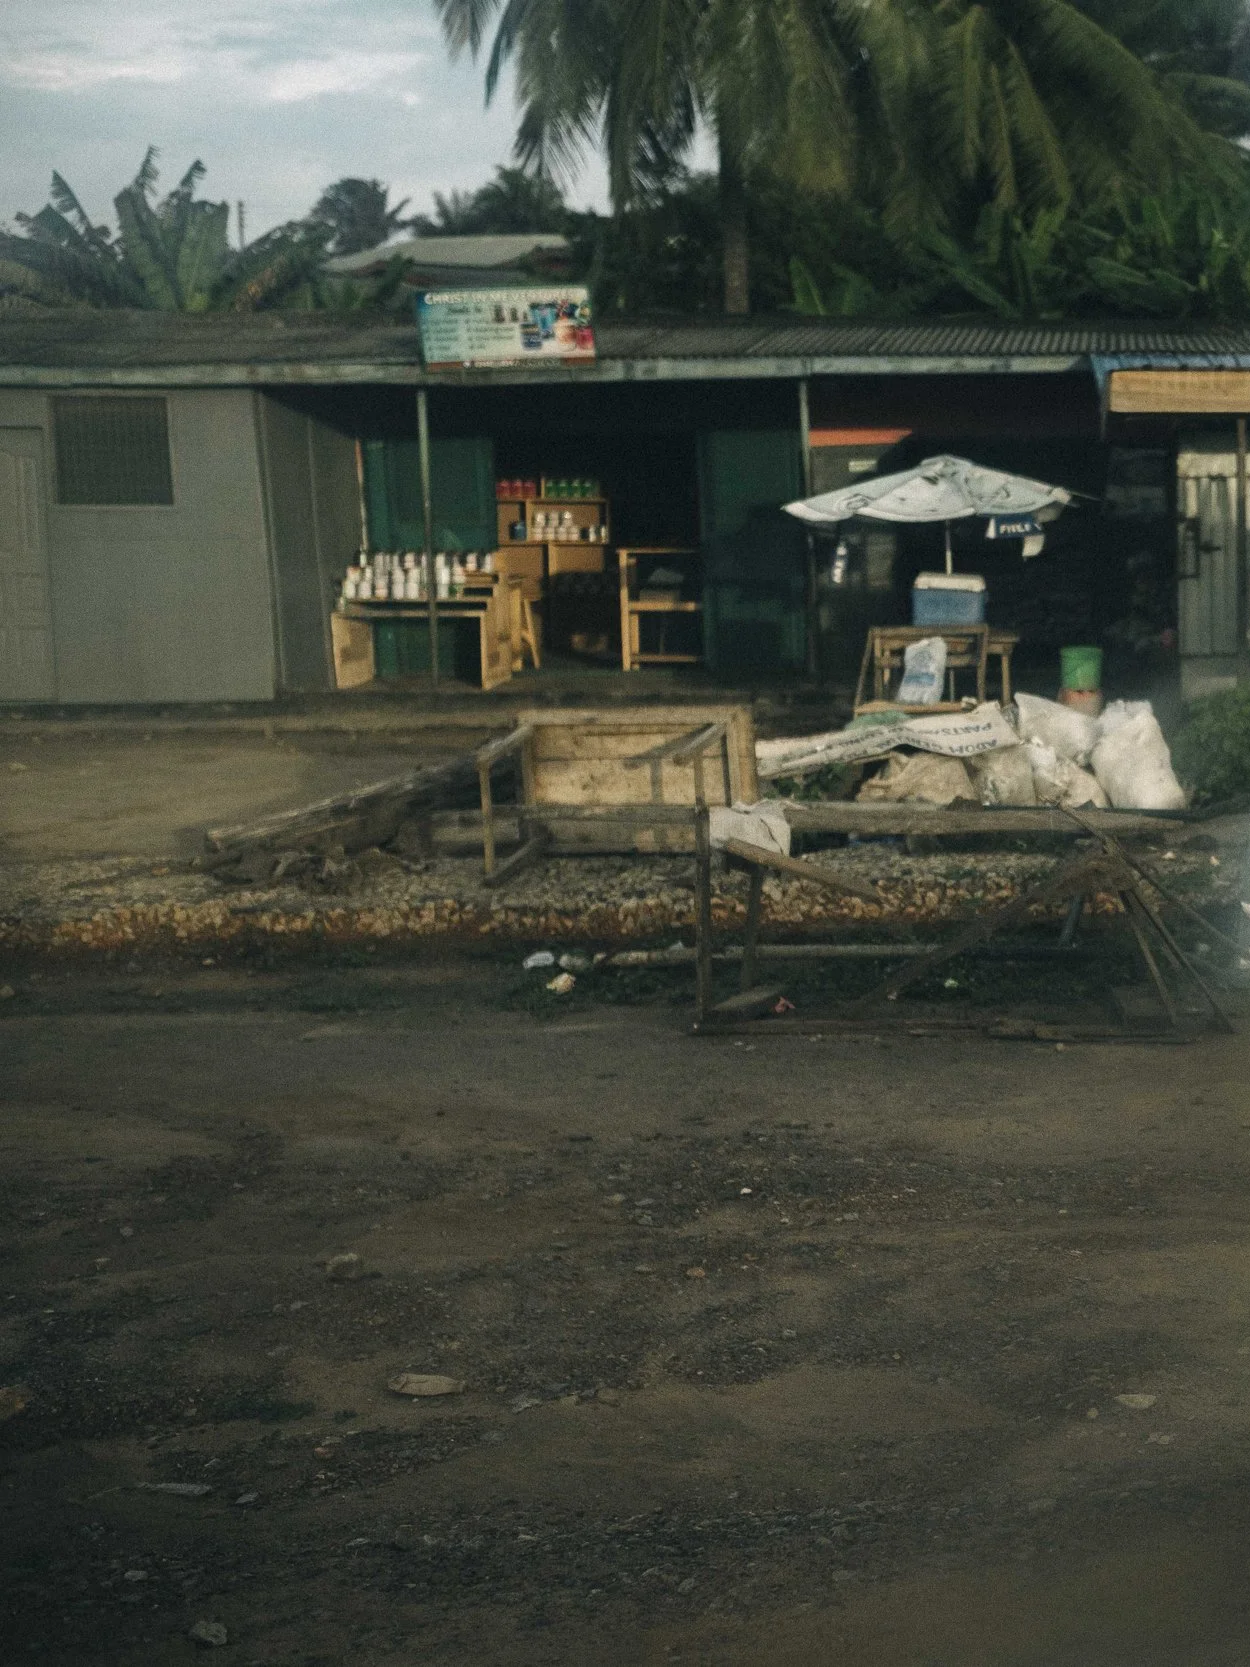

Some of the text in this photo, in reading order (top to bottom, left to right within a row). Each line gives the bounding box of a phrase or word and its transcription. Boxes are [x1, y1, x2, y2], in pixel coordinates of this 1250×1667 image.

[424, 292, 467, 304] CHRIST
[941, 722, 992, 736] PARTS
[948, 739, 997, 754] ADOM
